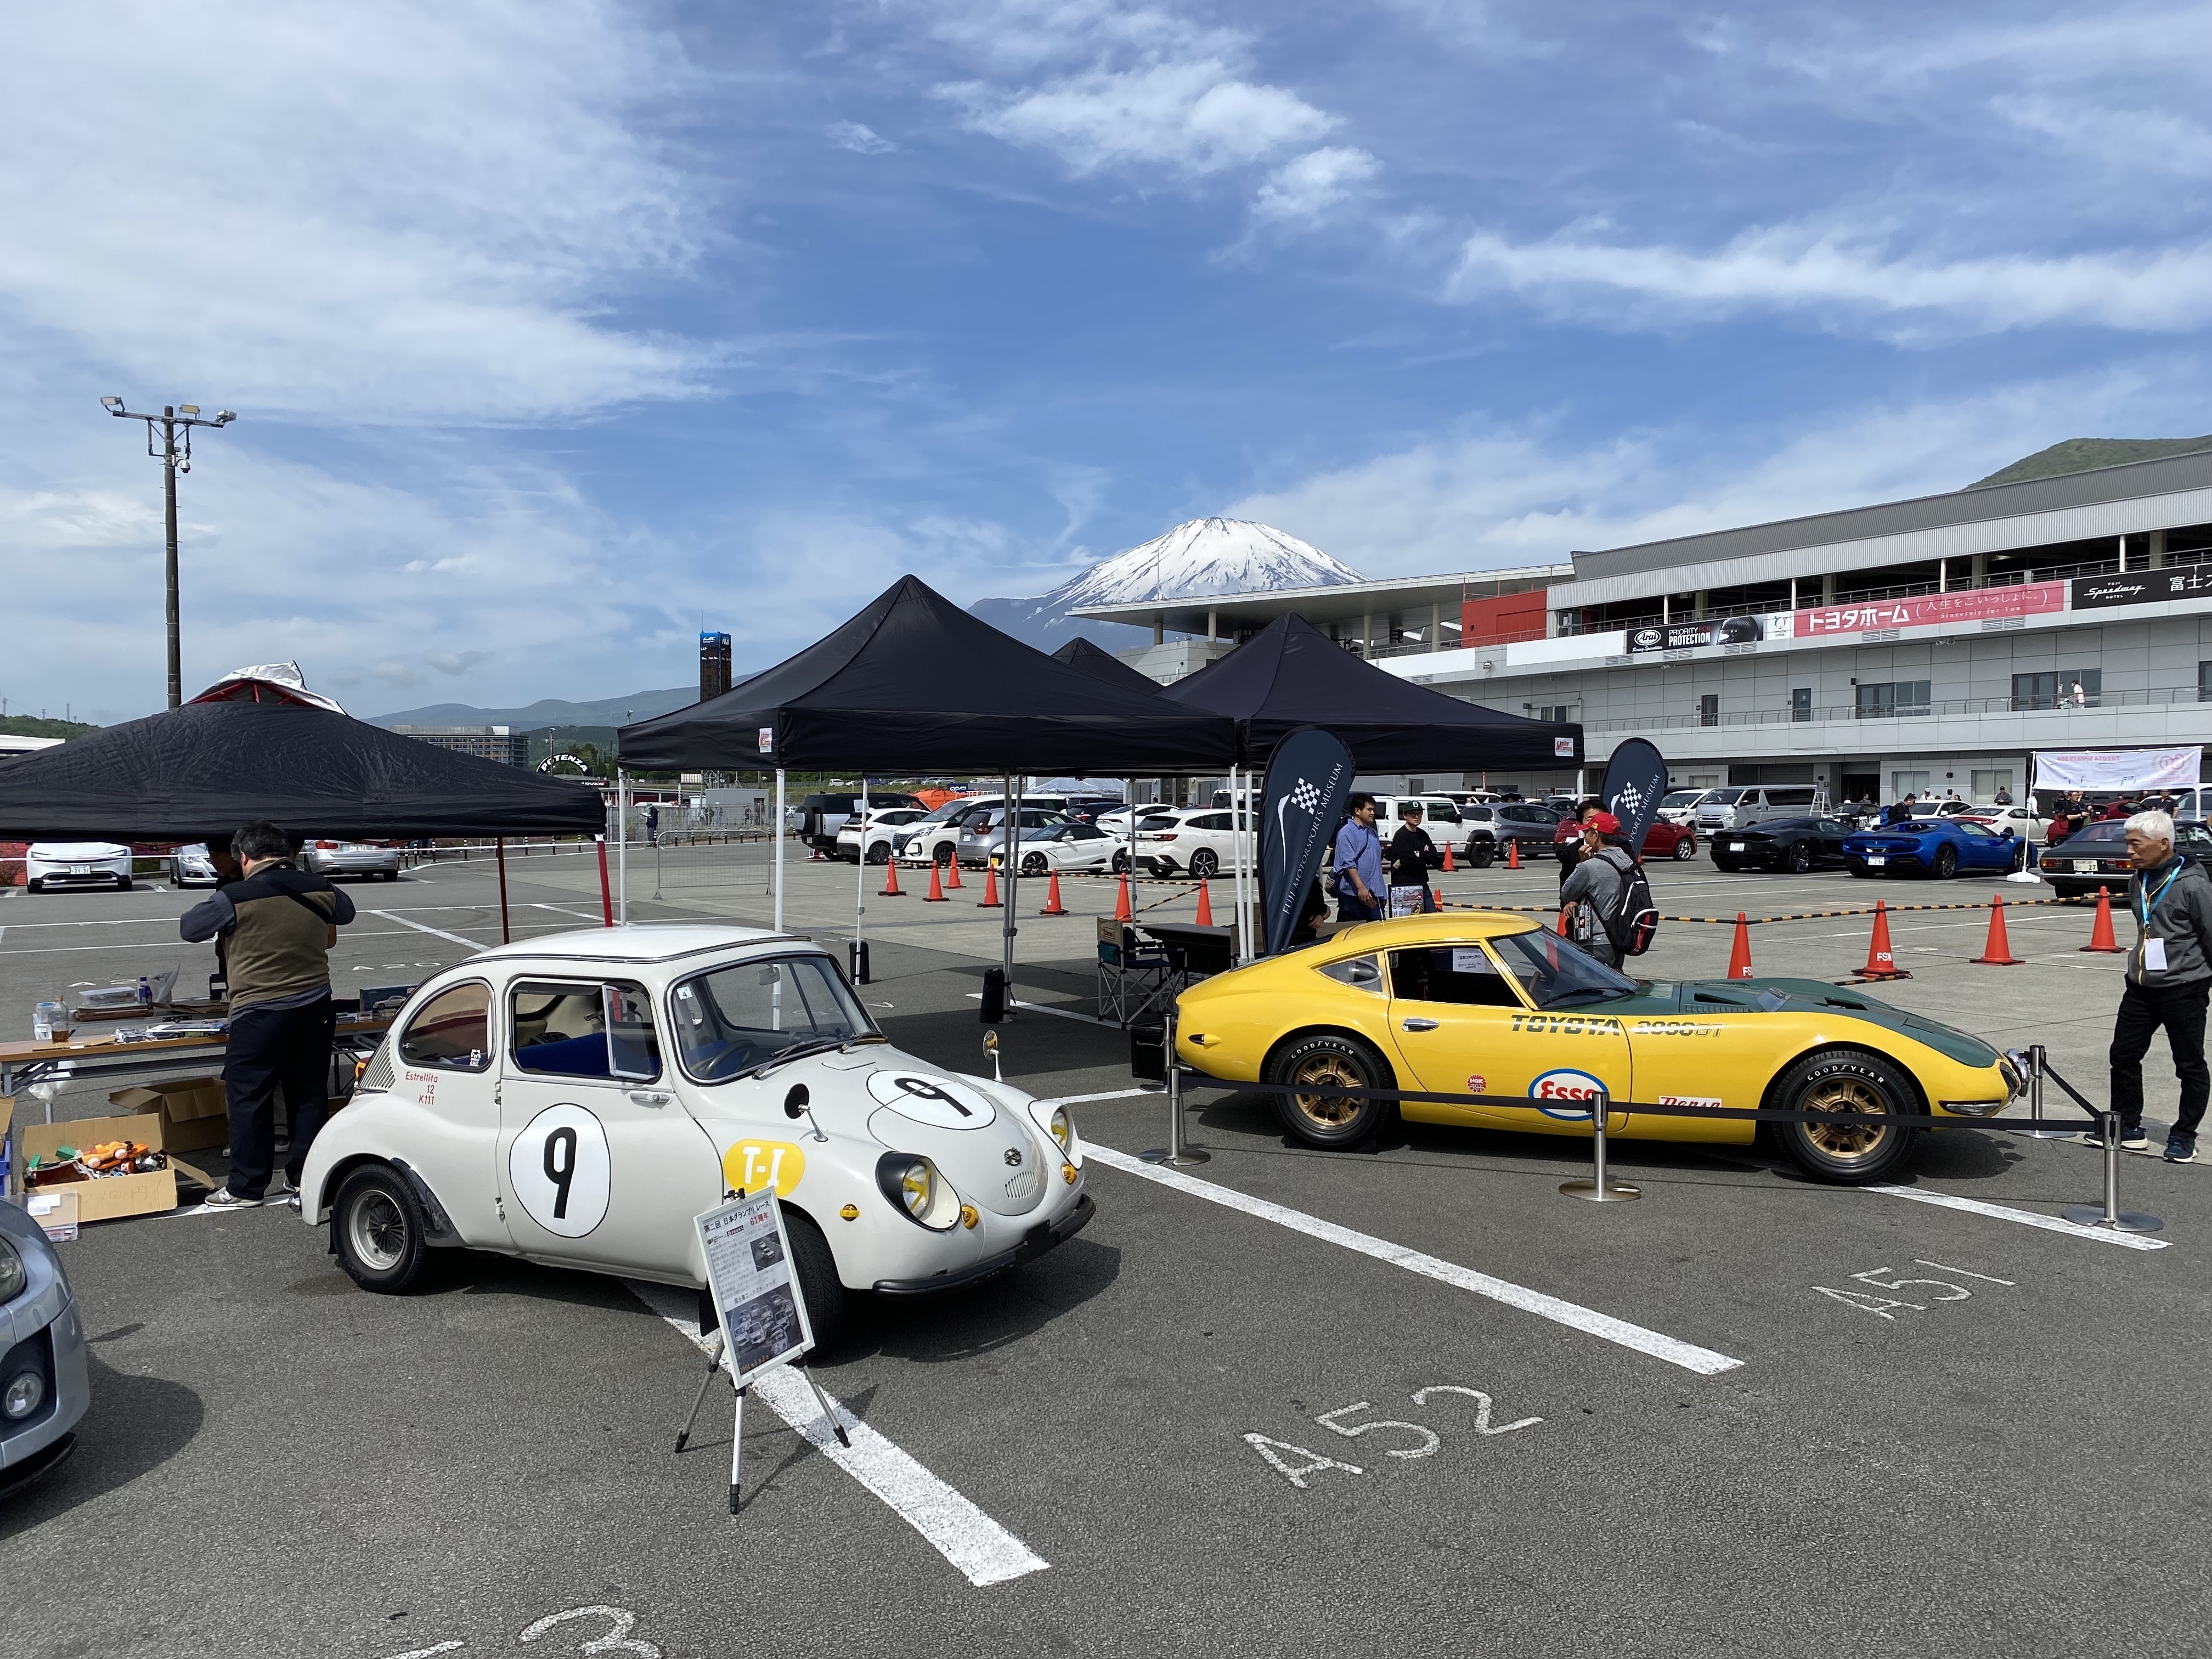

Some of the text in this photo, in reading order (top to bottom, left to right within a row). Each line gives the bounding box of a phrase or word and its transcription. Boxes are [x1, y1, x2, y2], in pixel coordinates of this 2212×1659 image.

[2084, 585, 2146, 600] Speedway
[1809, 605, 1910, 633] トヨタホーム
[1940, 610, 1982, 618] Sincerely
[1637, 631, 1657, 641] Arai
[1668, 627, 1699, 636] PRIORITY
[1668, 632, 1711, 647] PROTECTION
[540, 754, 588, 772] POTENZA
[1628, 774, 1661, 844] SPORTS MUSEUM
[1283, 762, 1344, 915] FUJI MOTORSPORTS MUSEUM
[1877, 952, 1892, 962] FSW
[1511, 1014, 1620, 1036] TOYOTA
[1291, 1040, 1354, 1059] GOODYEAR
[405, 1071, 438, 1083] Estrellita
[1807, 1064, 1884, 1083] GOODYEAR
[427, 1084, 435, 1094] 12
[894, 1077, 973, 1118] 9
[418, 1094, 435, 1105] K111
[544, 1127, 577, 1220] 9
[1810, 1259, 2016, 1321] A451
[1243, 1385, 1544, 1489] A452
